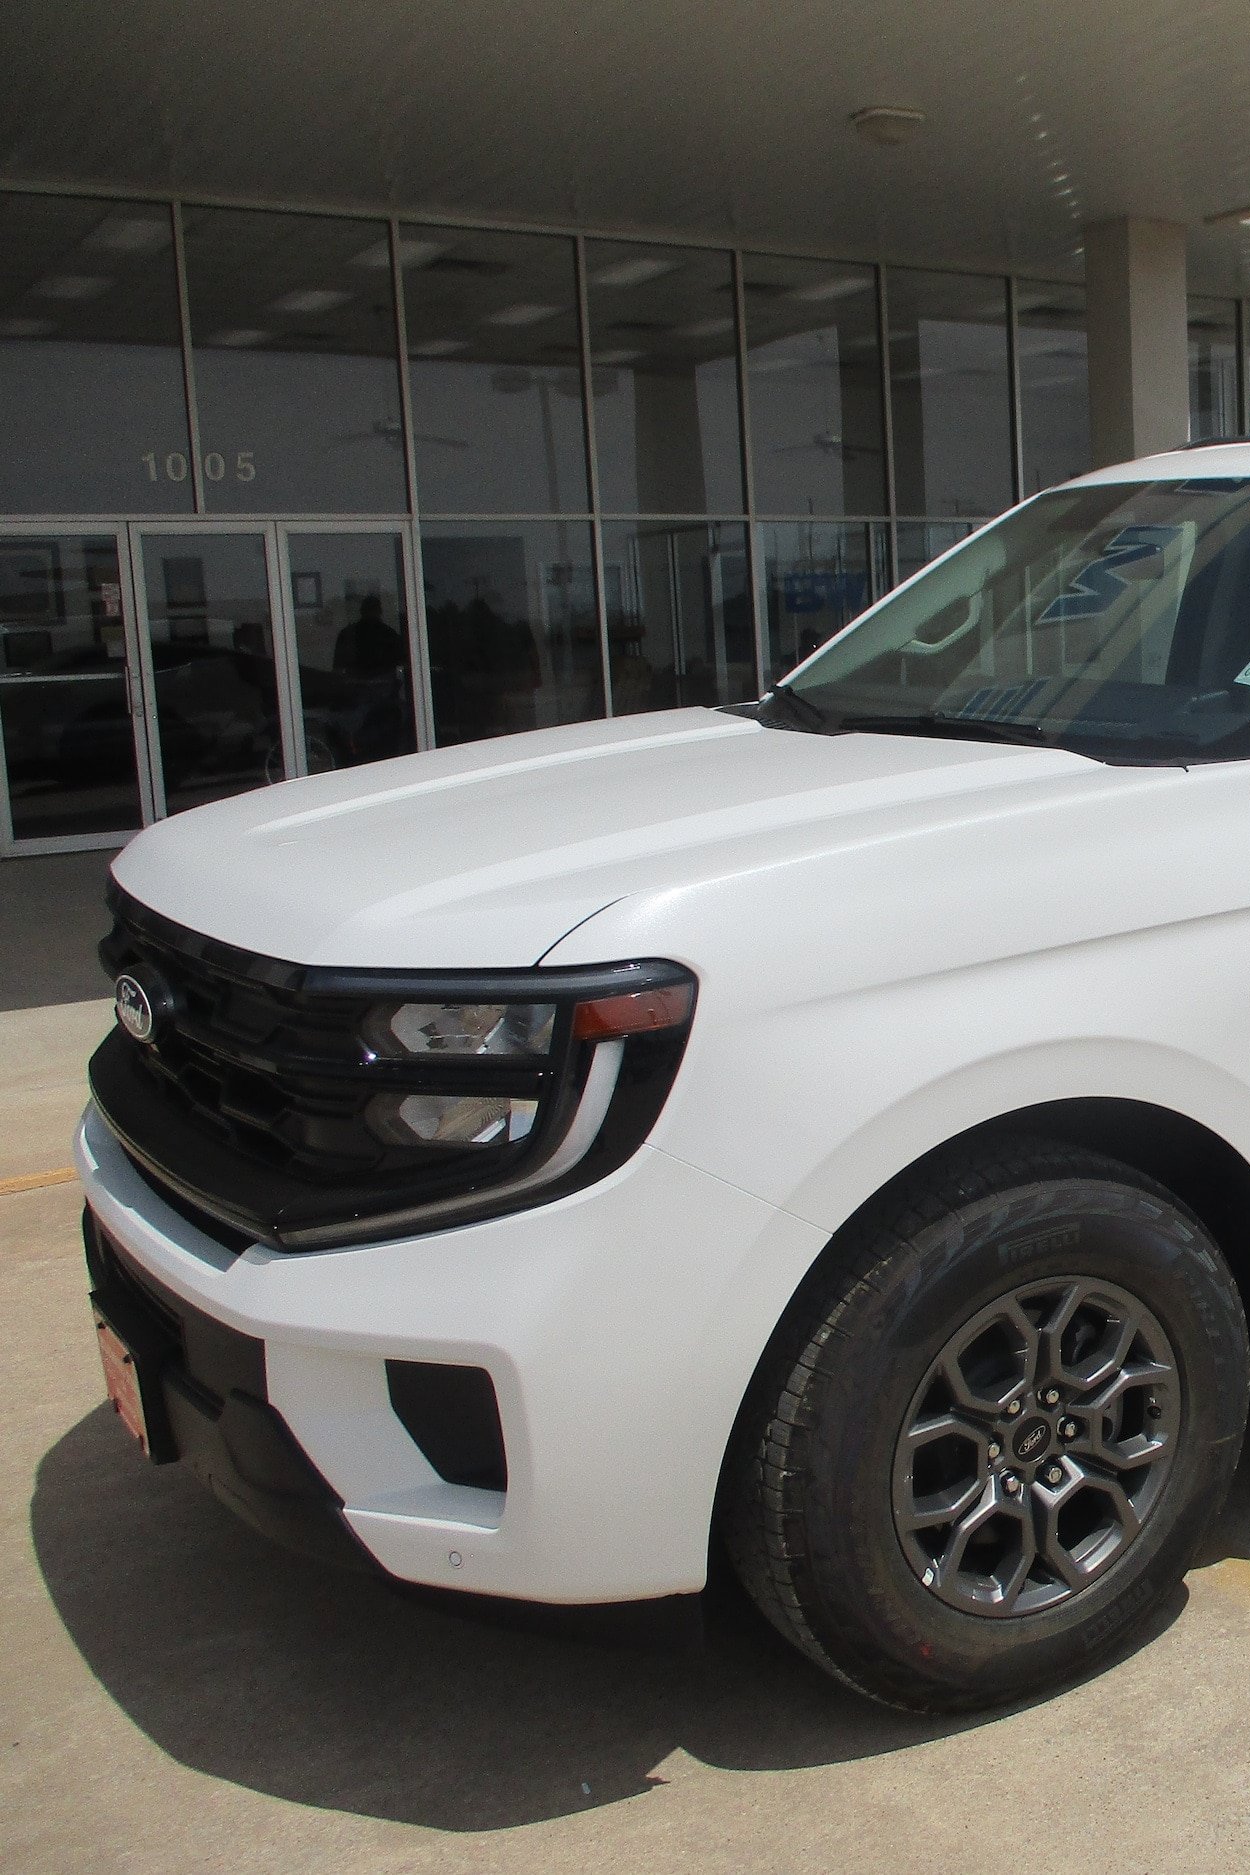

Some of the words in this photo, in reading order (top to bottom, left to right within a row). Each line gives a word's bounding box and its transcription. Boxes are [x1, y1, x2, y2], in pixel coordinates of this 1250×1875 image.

[141, 452, 256, 481] 1005
[118, 980, 145, 1031] Ford
[1022, 1429, 1042, 1451] Ford
